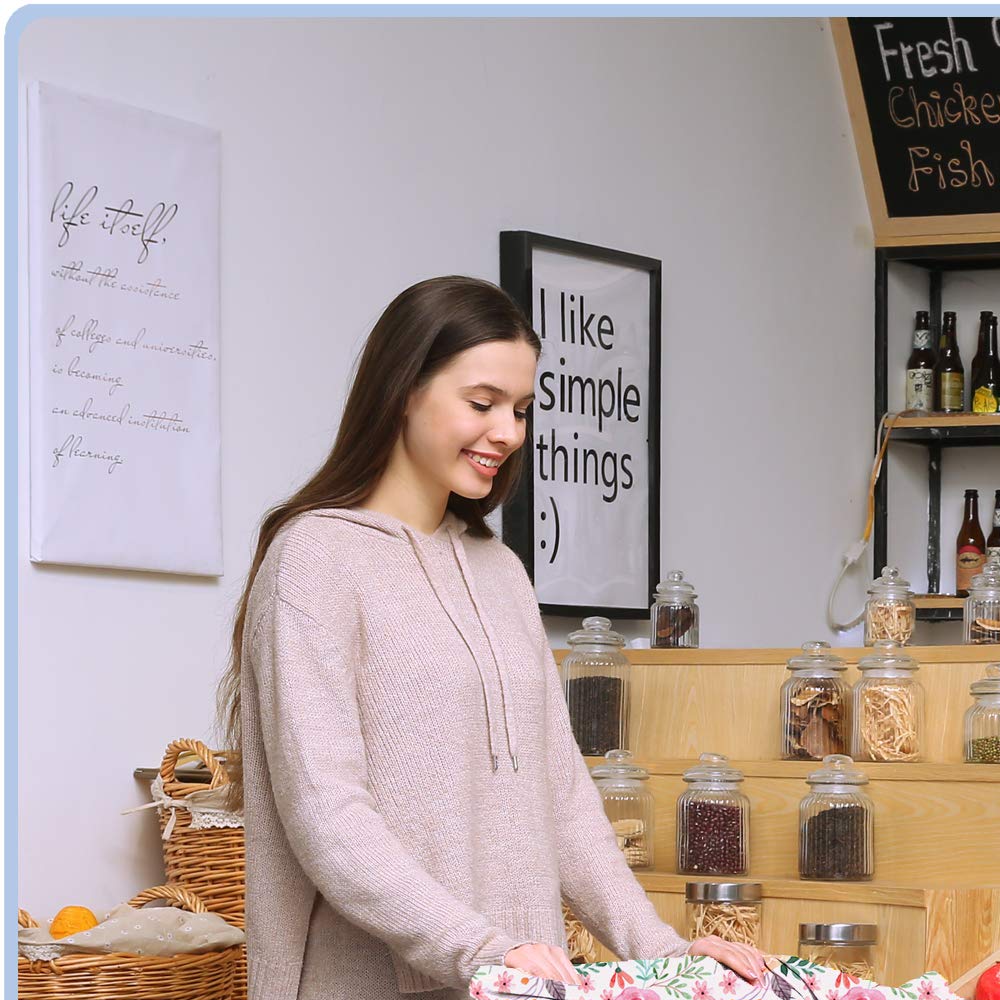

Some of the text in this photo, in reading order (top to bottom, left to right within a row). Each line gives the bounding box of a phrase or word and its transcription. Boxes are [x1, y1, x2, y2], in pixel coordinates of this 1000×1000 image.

[874, 17, 978, 81] Fresh
[908, 140, 994, 192] Fish
[51, 181, 98, 248] life
[55, 315, 75, 347] of
[71, 319, 111, 353] colleges
[116, 328, 146, 347] and
[540, 288, 615, 350] I like
[68, 356, 123, 396] becoming
[539, 357, 640, 432] simple
[52, 398, 191, 433] an advanced institution
[53, 434, 74, 468] of
[536, 429, 633, 502] things
